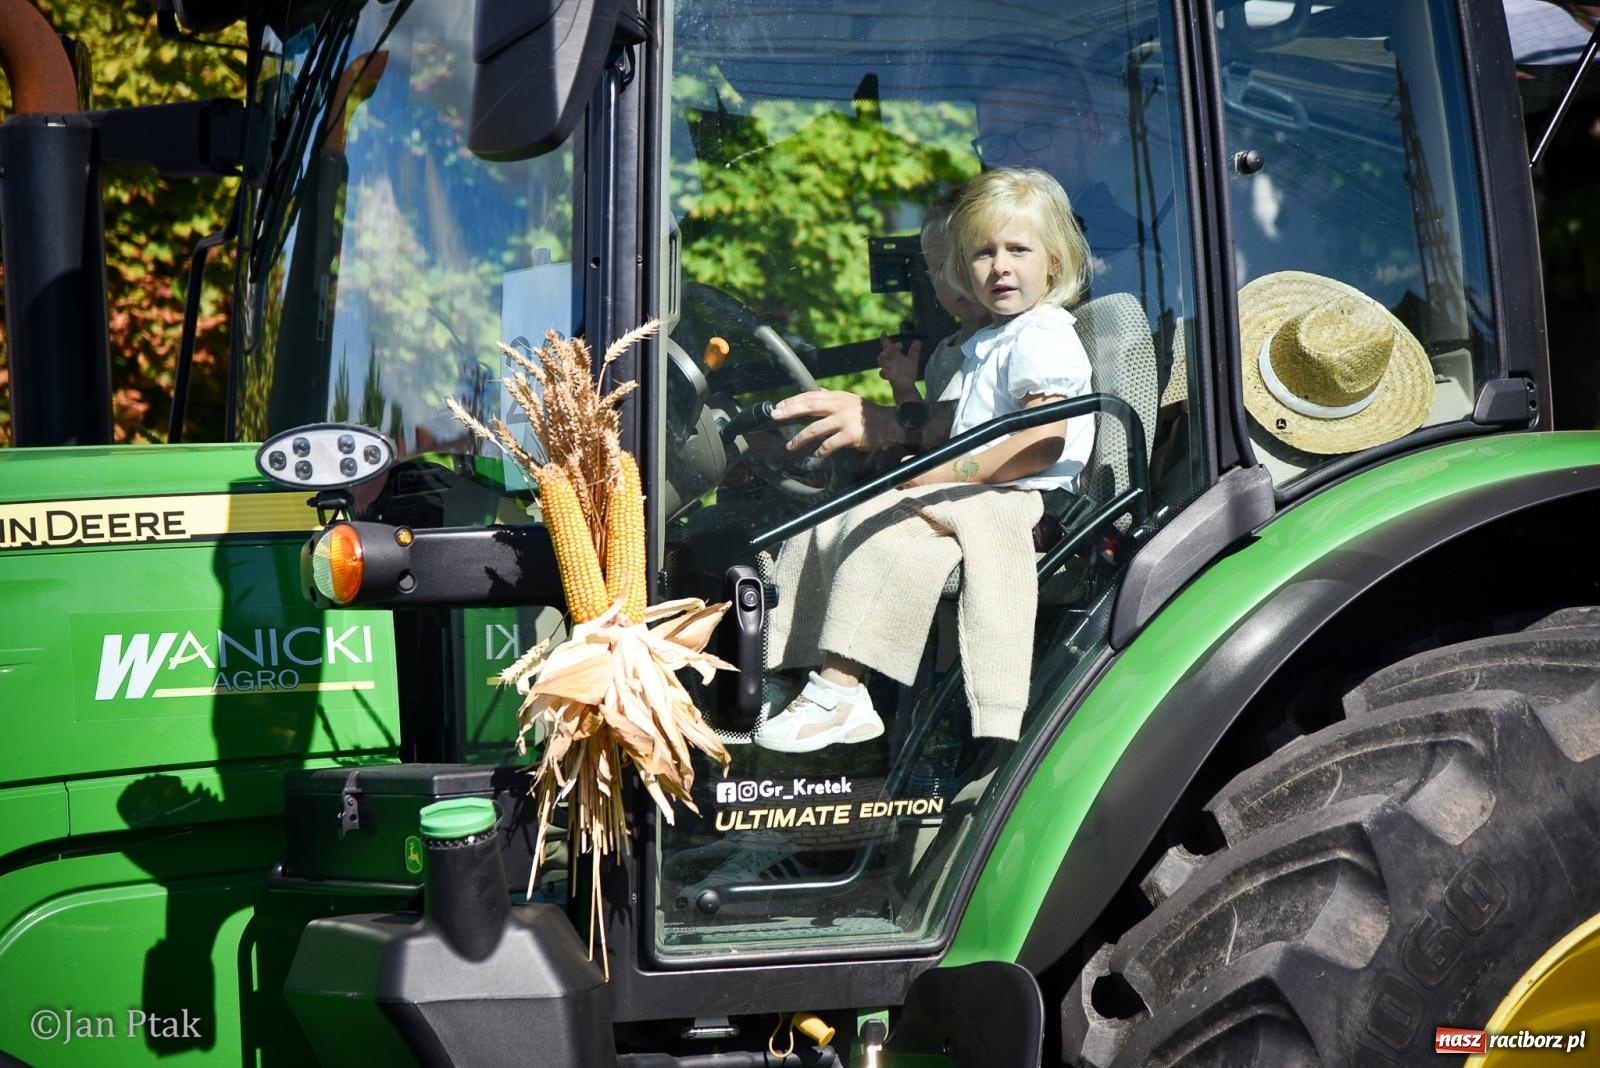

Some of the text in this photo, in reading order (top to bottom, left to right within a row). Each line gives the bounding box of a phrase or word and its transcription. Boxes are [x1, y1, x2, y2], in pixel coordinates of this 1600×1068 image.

[0, 510, 186, 543] N DEERE
[94, 625, 374, 701] WANICKI
[212, 669, 300, 693] AGRO
[758, 776, 853, 800] Gr_Kretek
[715, 798, 944, 832] ULTIMATE EDITION
